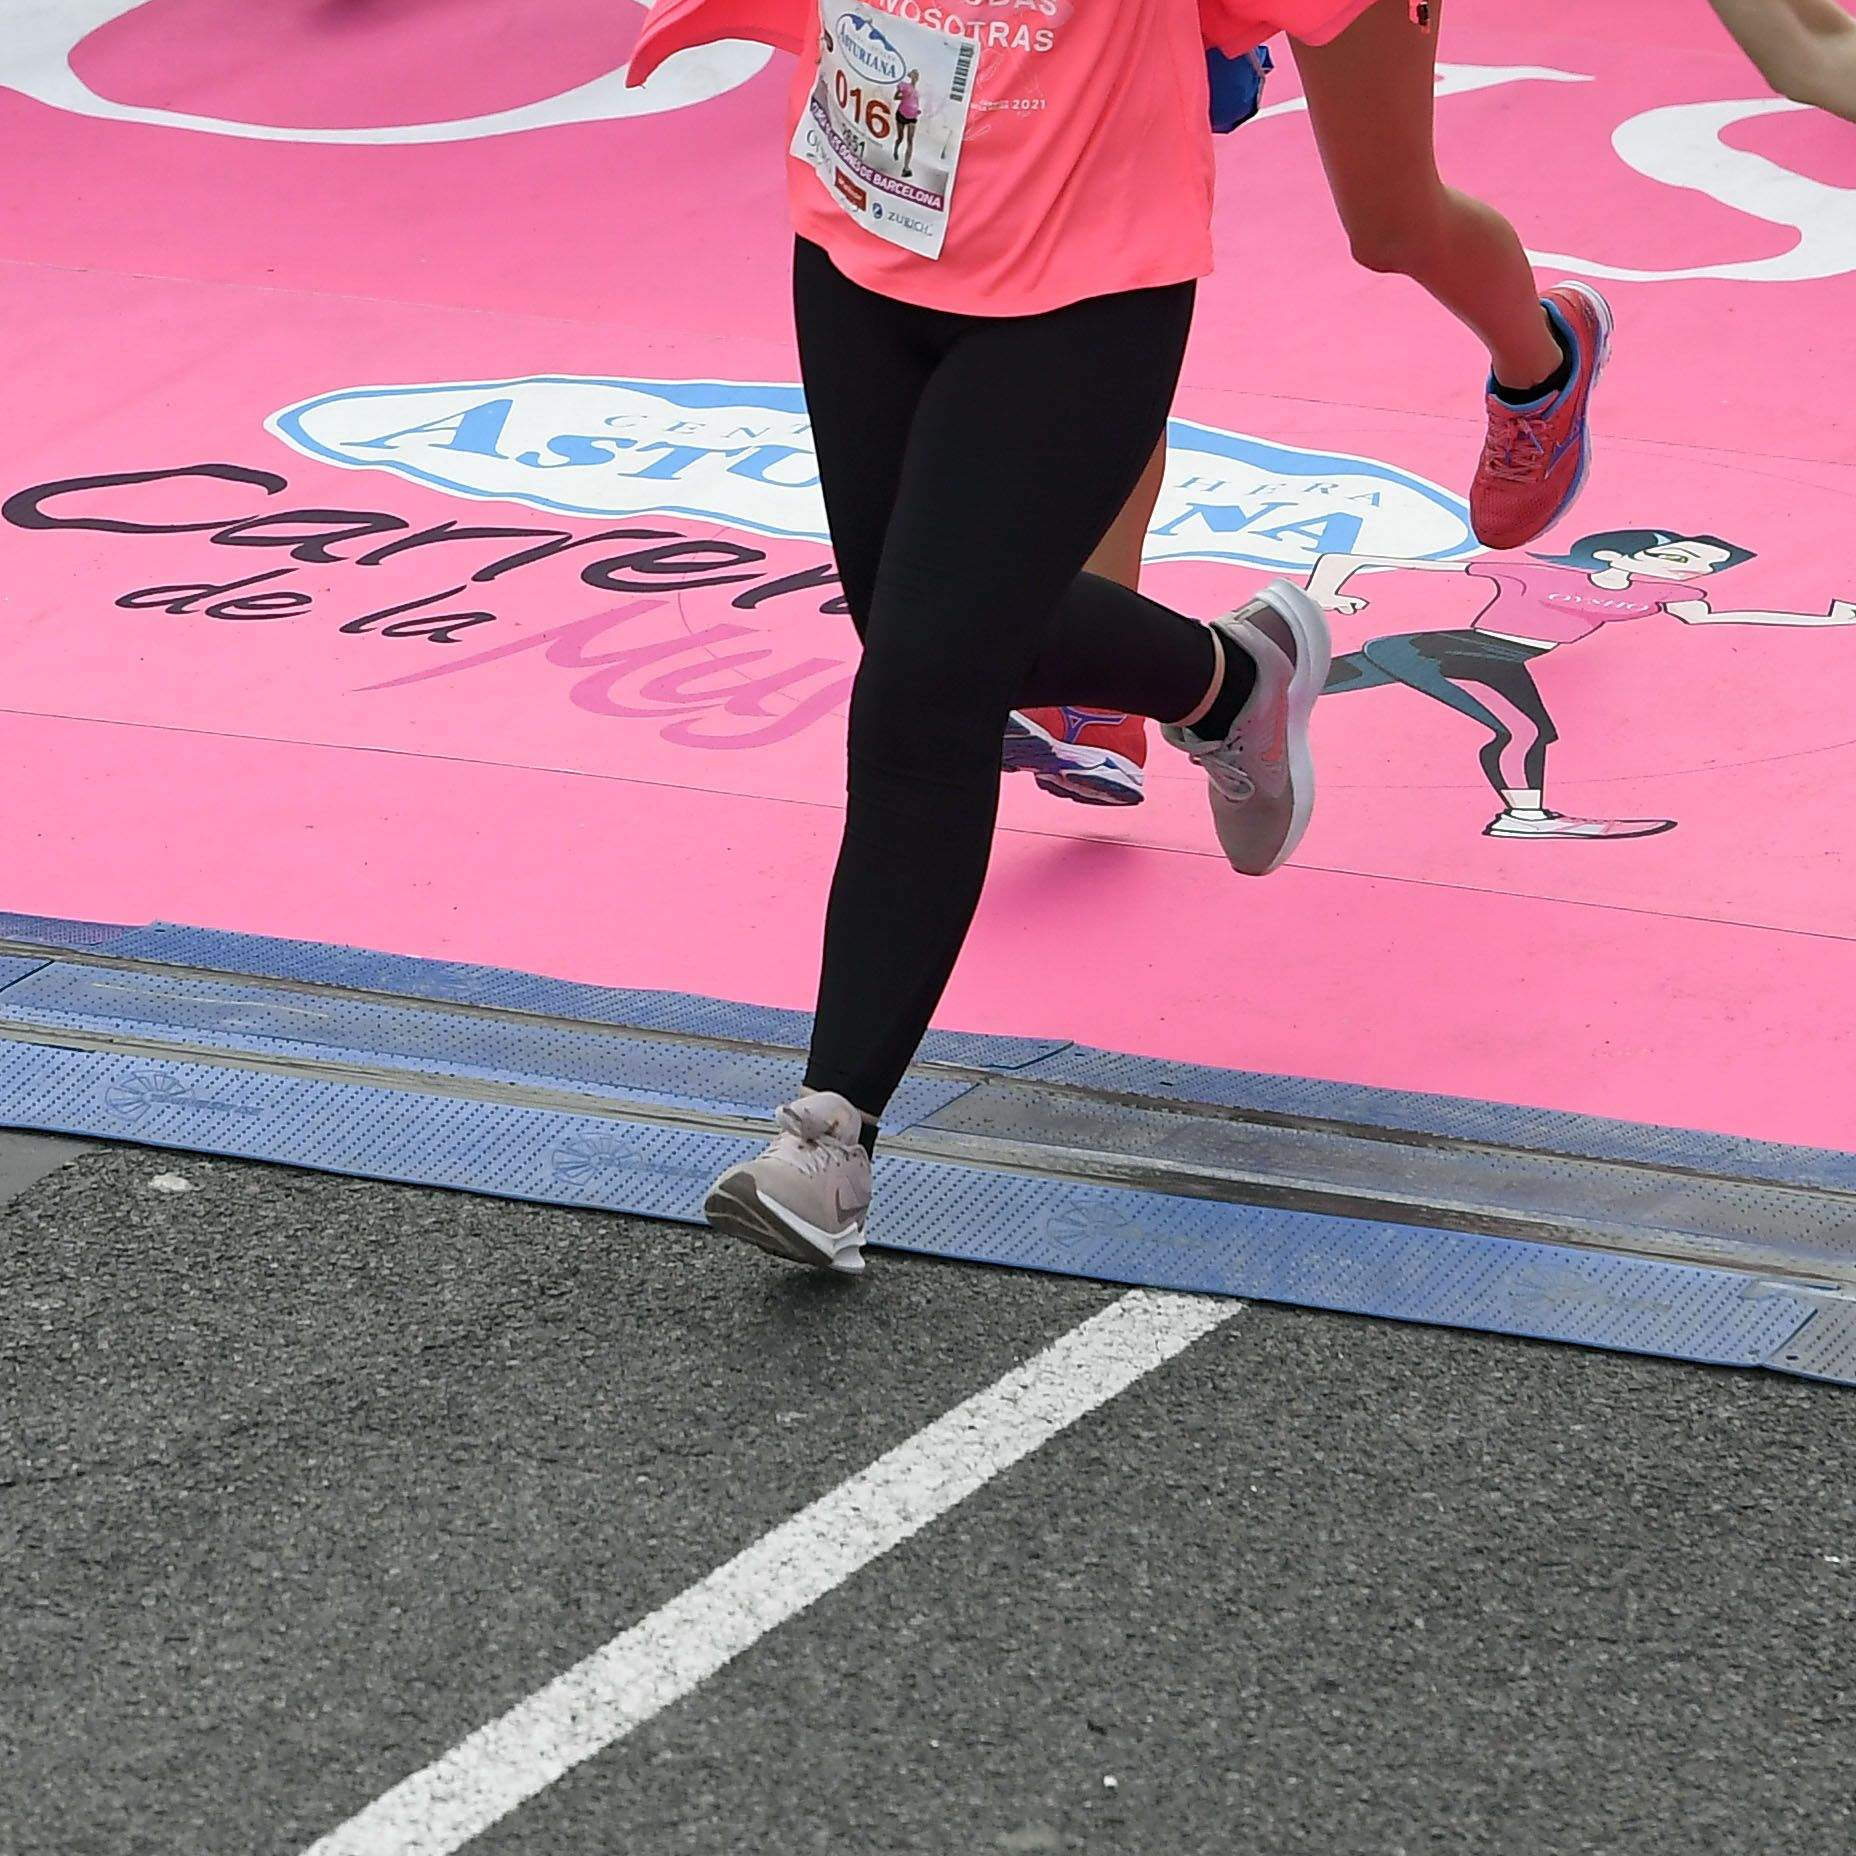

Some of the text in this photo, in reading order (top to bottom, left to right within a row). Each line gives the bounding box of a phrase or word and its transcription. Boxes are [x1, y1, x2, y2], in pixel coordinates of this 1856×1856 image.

[834, 69, 892, 139] 016
[873, 170, 943, 209] BARCELONA
[341, 398, 1364, 556] ASTUNA
[0, 463, 854, 618] Carrer
[114, 568, 498, 644] de la
